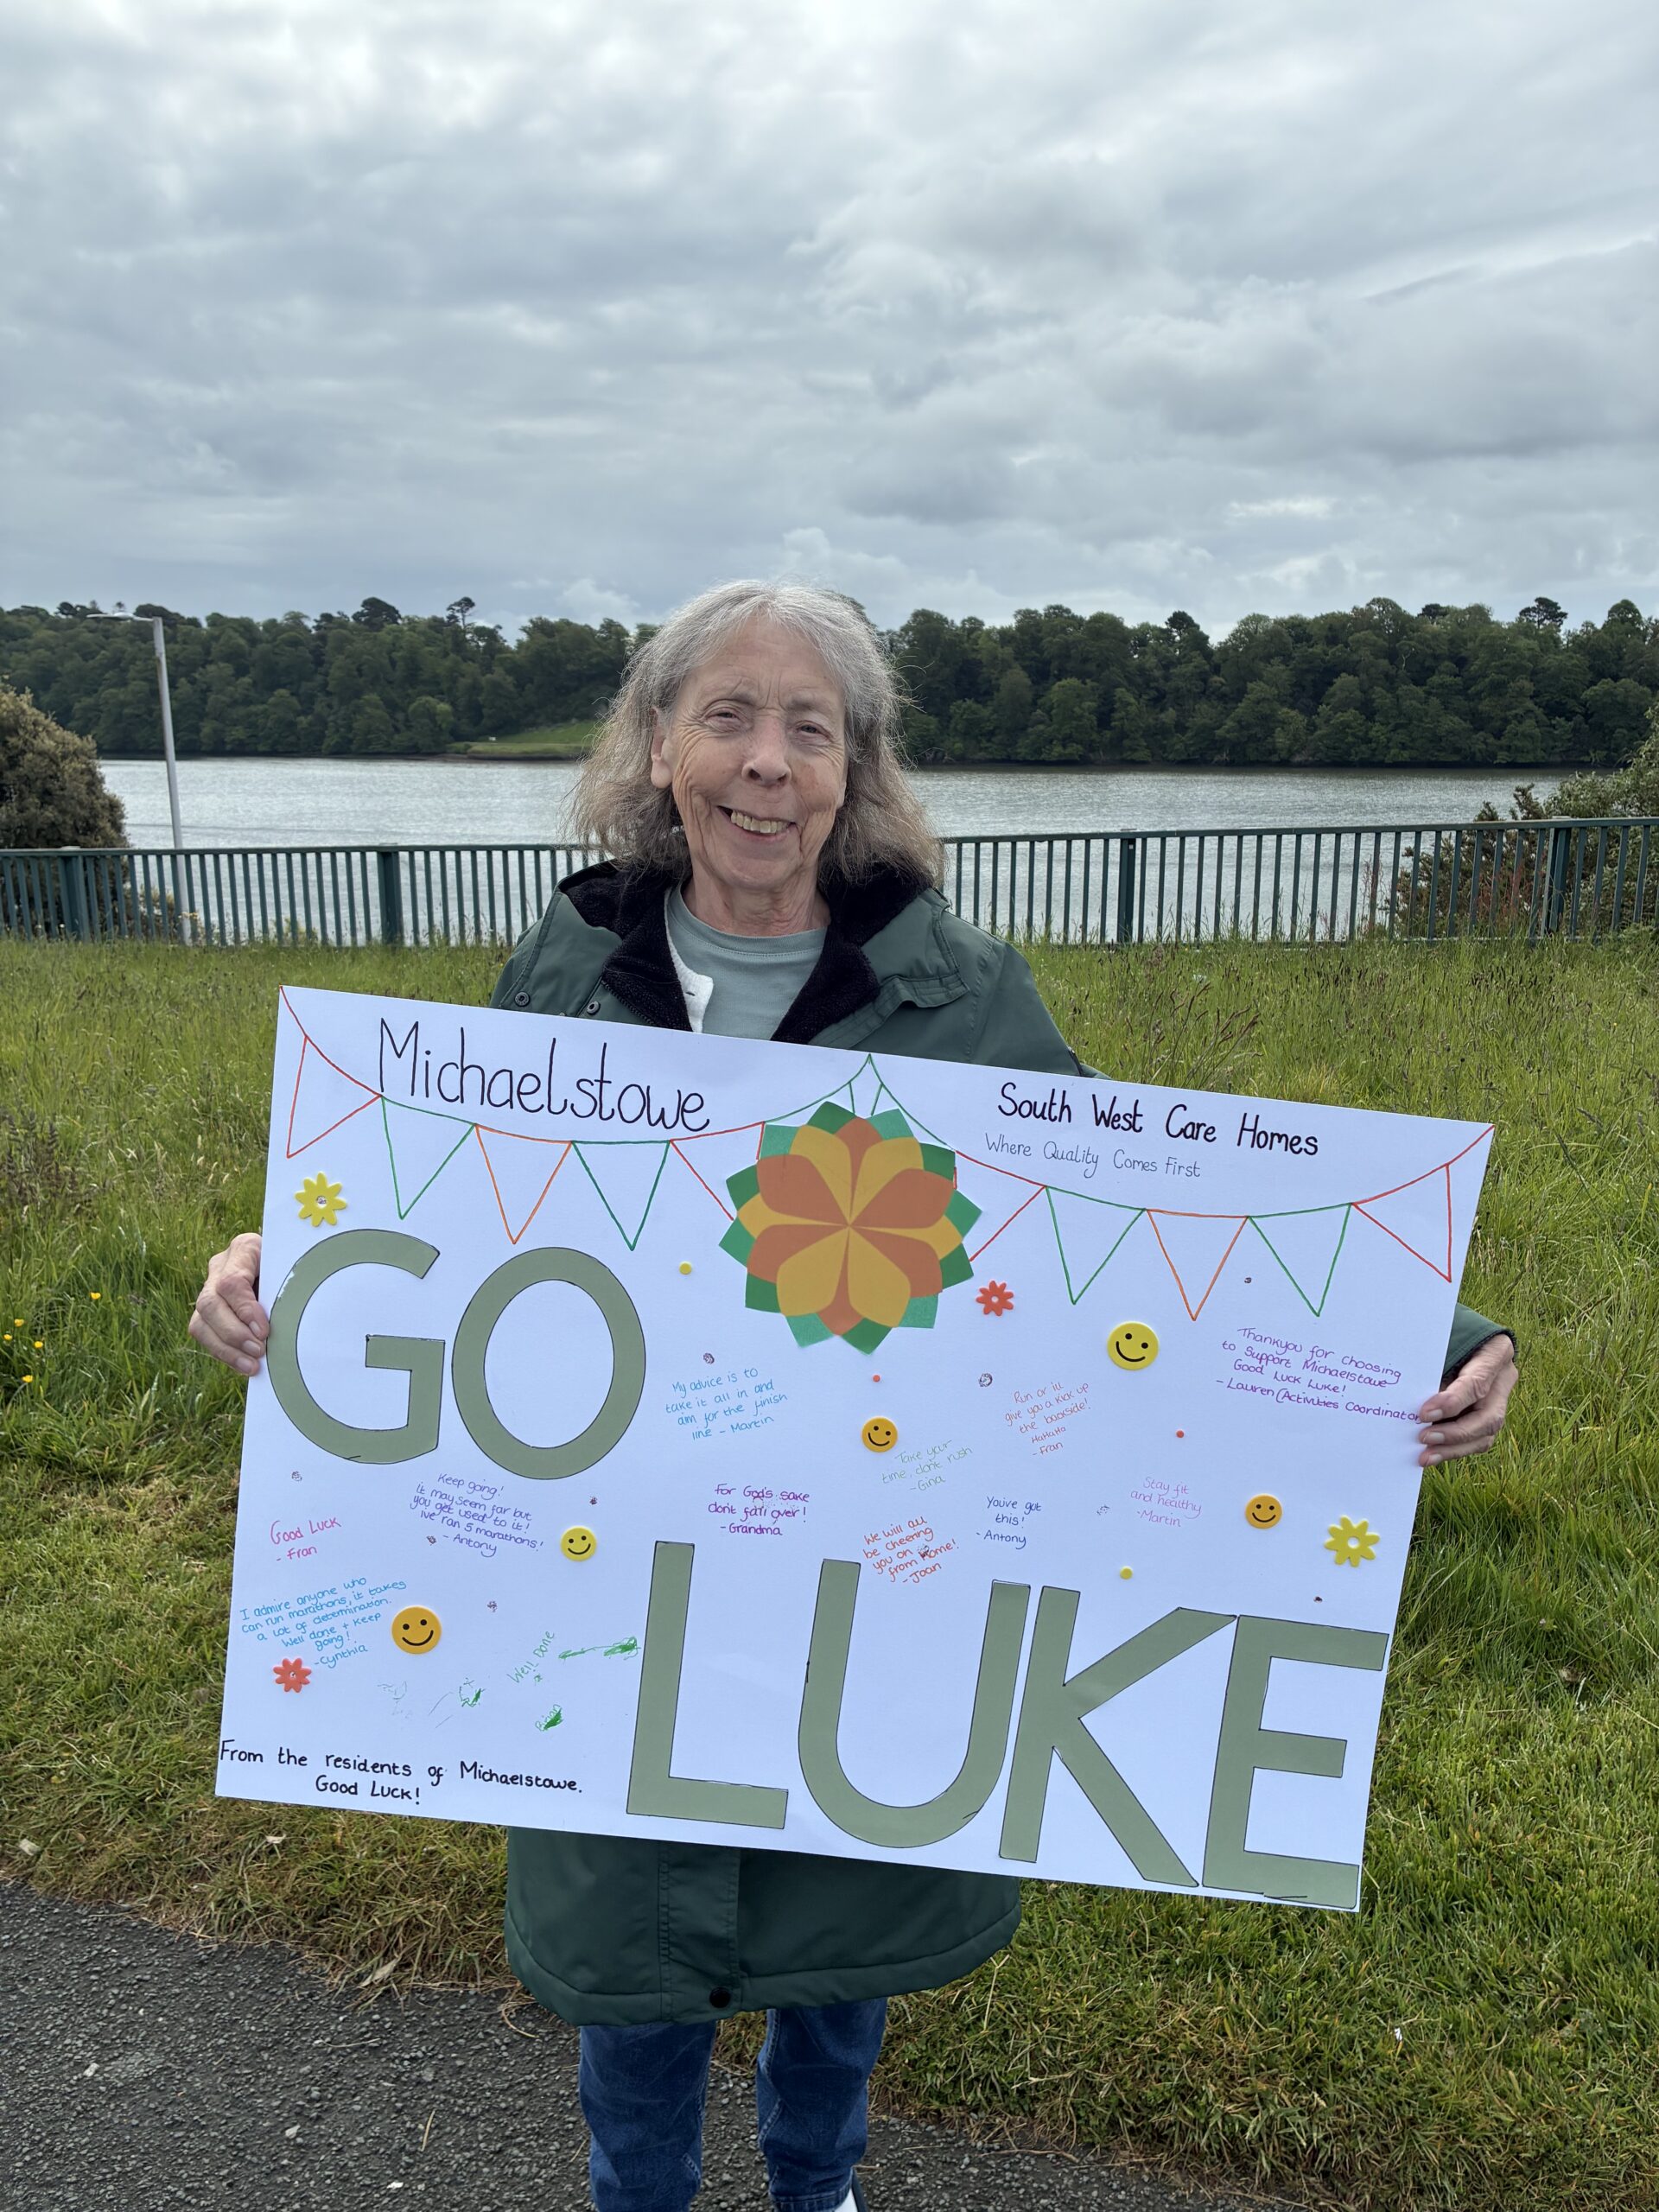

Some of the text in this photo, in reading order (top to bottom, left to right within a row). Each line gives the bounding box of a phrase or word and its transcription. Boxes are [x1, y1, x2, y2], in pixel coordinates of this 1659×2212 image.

[379, 1017, 710, 1132] Michaelstowe
[998, 1082, 1319, 1156] South West Care Homes
[985, 1133, 1201, 1179] Where Quality Comes First
[266, 1229, 646, 1480] GO
[1222, 1340, 1236, 1351] to
[1302, 1359, 1388, 1389] Michaelstowe
[1309, 1346, 1334, 1362] for
[1341, 1355, 1402, 1385] choosing
[672, 1368, 759, 1399] My advice is to
[1234, 1358, 1265, 1376] Good
[1307, 1378, 1346, 1397] Luke!
[665, 1378, 774, 1414] take it all in and
[677, 1393, 788, 1428] aim for the finish
[1005, 1410, 1022, 1427] give
[1027, 1403, 1044, 1420] you
[1077, 1382, 1090, 1395] up
[1014, 1391, 1033, 1404] Run
[1037, 1387, 1047, 1398] or
[692, 1426, 713, 1440] line
[730, 1415, 775, 1433] Martin
[1019, 1421, 1038, 1434] the
[894, 1439, 952, 1464] Take your
[947, 1446, 973, 1464] rush
[437, 1473, 505, 1501] Keep going!
[715, 1483, 737, 1496] For
[779, 1491, 810, 1503] sake
[1143, 1476, 1190, 1499] Stay fit
[410, 1495, 430, 1510] you
[435, 1503, 454, 1516] get
[458, 1509, 486, 1523] used
[493, 1516, 507, 1528] to
[430, 1489, 454, 1505] may
[486, 1504, 511, 1519] far
[512, 1508, 532, 1522] but
[708, 1502, 737, 1515] don't
[740, 1507, 767, 1522] fall
[1130, 1490, 1202, 1520] and healthy
[270, 1516, 342, 1545] Good Luck
[441, 1516, 461, 1529] ran
[464, 1522, 474, 1532] 5
[475, 1527, 544, 1552] marathons!
[863, 1533, 881, 1546] We
[882, 1523, 904, 1538] will
[995, 1512, 1025, 1529] this!
[862, 1548, 881, 1560] be
[873, 1549, 913, 1575] you on
[888, 1559, 918, 1583] from
[240, 1577, 367, 1621] I admire anyone who
[266, 1616, 284, 1626] run
[353, 1591, 364, 1601] it
[257, 1633, 268, 1642] a
[296, 1621, 308, 1635] of
[308, 1625, 337, 1641] done
[532, 1630, 556, 1658] Done
[626, 1541, 1389, 1910] LUKE
[219, 1738, 584, 1794] From the residents of Michaelstowe.
[315, 1774, 421, 1806] Good Luck!
